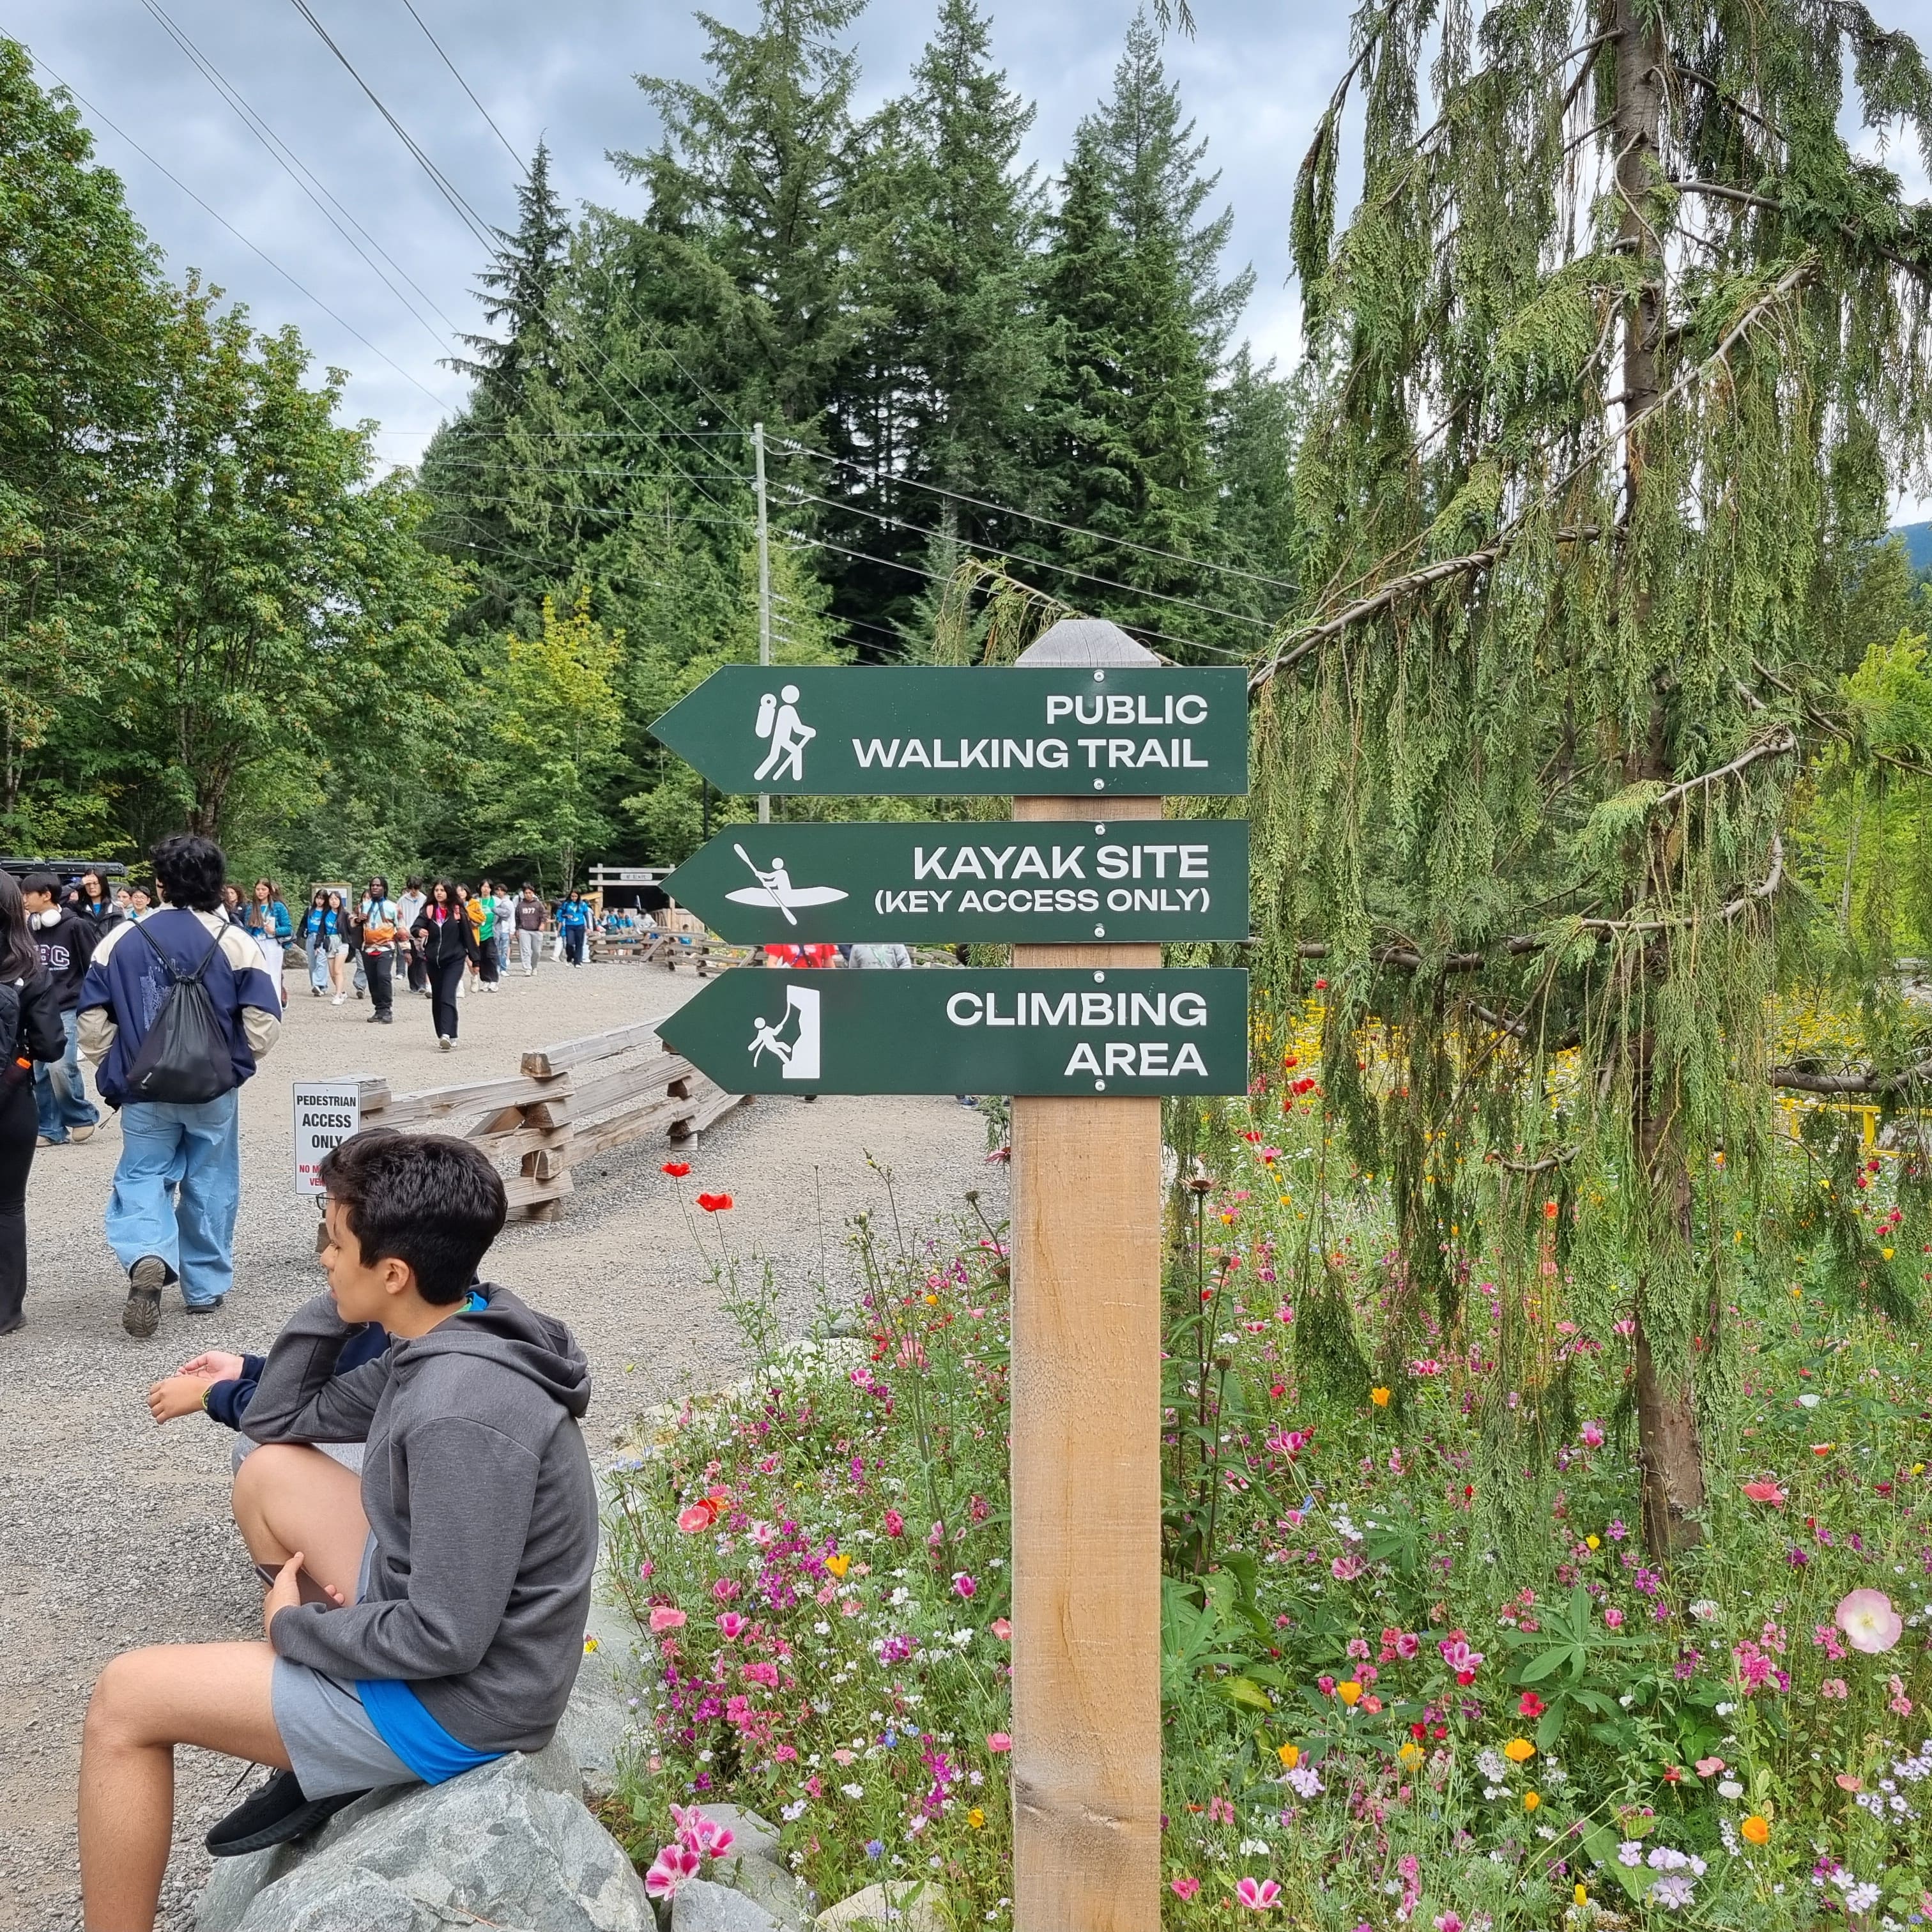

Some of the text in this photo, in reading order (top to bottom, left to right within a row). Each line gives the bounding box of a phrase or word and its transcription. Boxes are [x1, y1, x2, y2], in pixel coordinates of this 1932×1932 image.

[1046, 694, 1209, 725] PUBLIC
[852, 738, 1209, 769] WALKING TRAIL
[914, 845, 1209, 880] KAYAK SITE
[874, 887, 1211, 915] (KEY ACCESS ONLY)
[946, 991, 1208, 1027] CLIMBING
[1063, 1043, 1209, 1077] AREA
[296, 1095, 356, 1107] PEDESTRIAN
[302, 1113, 352, 1128] ACCESS
[312, 1134, 343, 1149] ONLY
[299, 1165, 310, 1173] NO
